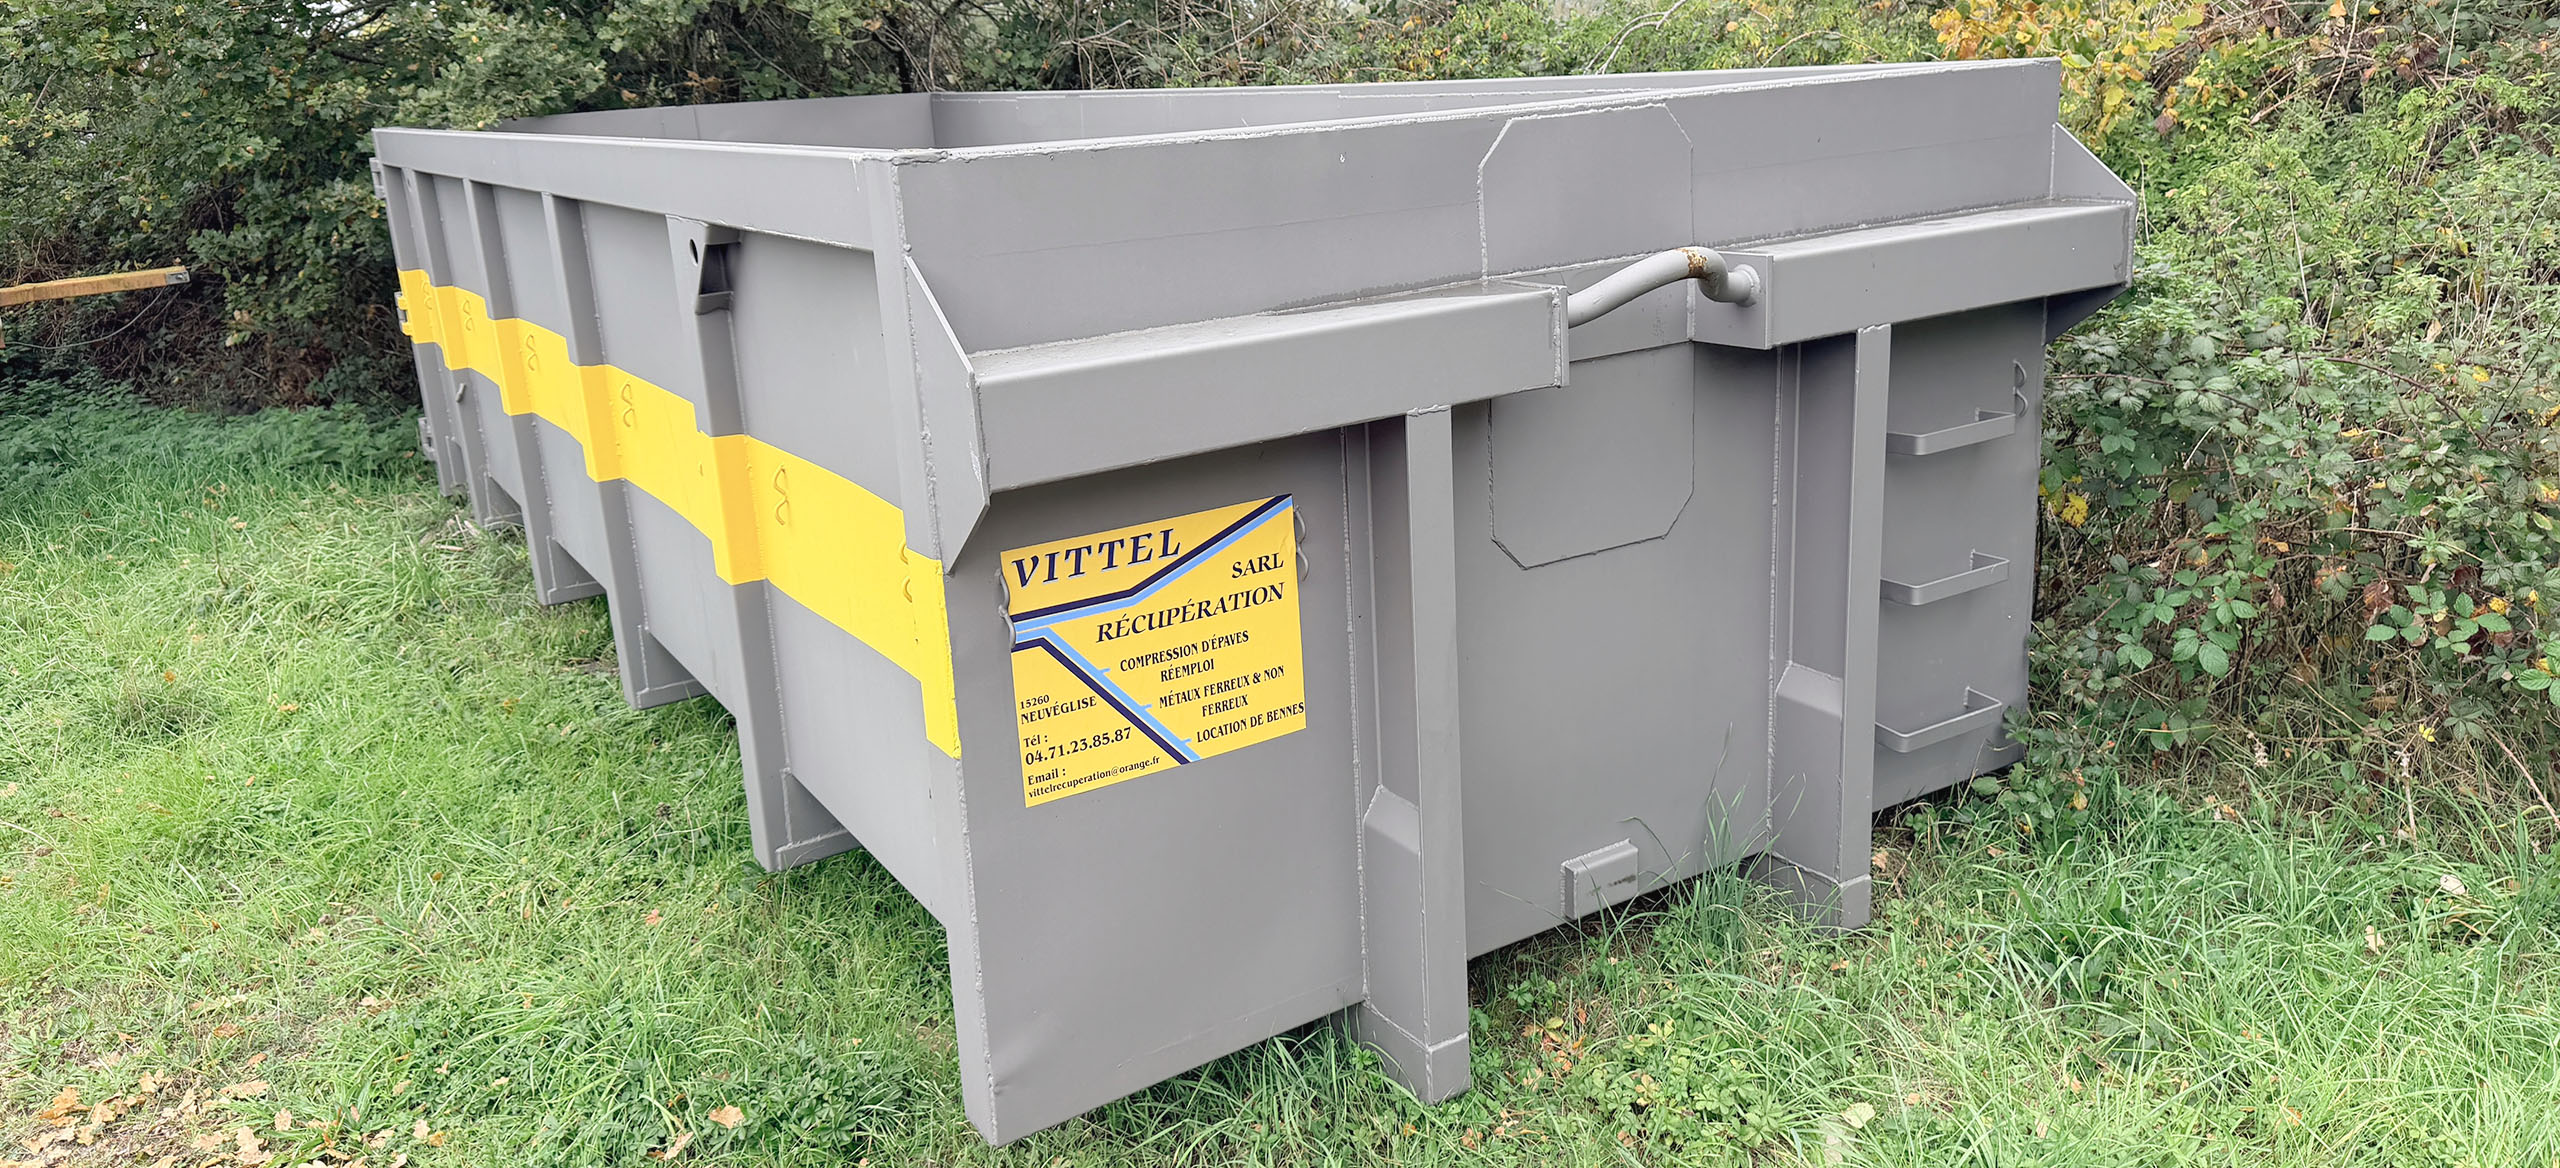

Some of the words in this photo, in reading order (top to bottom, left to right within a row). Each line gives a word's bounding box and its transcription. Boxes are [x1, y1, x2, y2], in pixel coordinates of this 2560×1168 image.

[1012, 528, 1181, 588] VITTEL
[1231, 552, 1284, 579] SARL
[1096, 582, 1285, 643] RÉCUPÉRATION
[1120, 642, 1198, 672] COMPRESSION
[1202, 630, 1249, 654] D'ÉPAVES
[1159, 689, 1201, 709] MÉTAUX
[1204, 675, 1250, 698] FERREUX
[1252, 672, 1261, 684] &
[1264, 665, 1285, 678] NON
[1160, 659, 1215, 682] RÉEMPLOI
[1019, 694, 1050, 710] 15260
[1020, 695, 1097, 725] NEUVÉGLISE
[1202, 694, 1249, 717] FERREUX
[1197, 720, 1247, 743] LOCATION
[1250, 715, 1264, 729] DE
[1267, 702, 1304, 724] BENNES
[1023, 734, 1041, 748] Tél
[1025, 727, 1132, 766] 04.71.23.85.87
[1027, 768, 1060, 786] Email
[1028, 755, 1160, 798] vittelrecuperation@orange.fr
